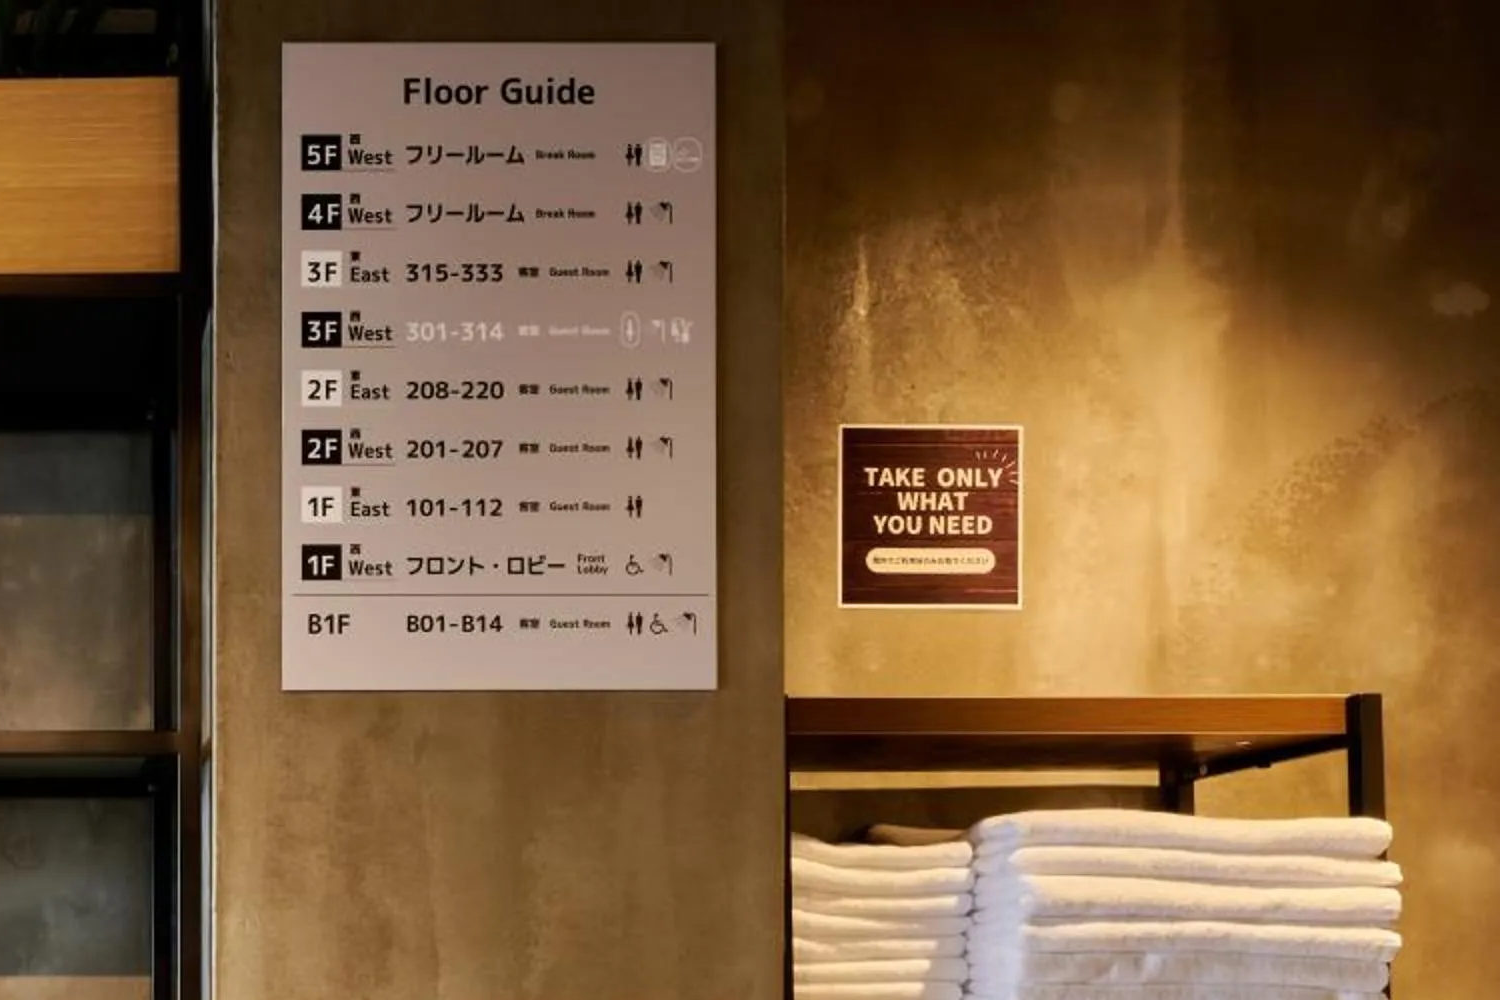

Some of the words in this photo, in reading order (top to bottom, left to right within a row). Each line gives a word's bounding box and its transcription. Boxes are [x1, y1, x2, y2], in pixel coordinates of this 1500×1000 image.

[404, 77, 489, 106] Floor
[499, 77, 596, 106] Guide
[307, 144, 338, 166] 5F
[348, 148, 393, 165] West
[405, 144, 525, 165] フリールーム
[307, 203, 340, 224] 4F
[348, 207, 392, 224] West
[405, 203, 525, 224] フリールーム
[307, 262, 338, 283] 3F
[350, 266, 390, 283] East
[406, 263, 504, 283] 315-333
[307, 320, 338, 342] 3F
[348, 325, 393, 342] West
[406, 321, 505, 342] 301-314
[307, 379, 338, 400] 2F
[350, 383, 390, 400] East
[406, 380, 505, 400] 208-220
[307, 438, 338, 459] 2F
[348, 442, 393, 459] West
[406, 439, 504, 460] 201-207
[864, 467, 926, 487] TAKE
[937, 467, 1003, 488] ONLY
[307, 496, 335, 517] 1F
[350, 501, 390, 517] East
[406, 498, 503, 517] 101-112
[897, 491, 969, 511] WHAT
[873, 515, 923, 535] YOU
[929, 515, 993, 535] NEED
[307, 554, 336, 576] 1F
[348, 559, 393, 577] West
[406, 554, 566, 576] フロント・ロビー
[577, 553, 605, 564] Front
[577, 564, 609, 576] Lobby
[307, 613, 351, 635] B1F
[406, 614, 504, 634] B01-B14
